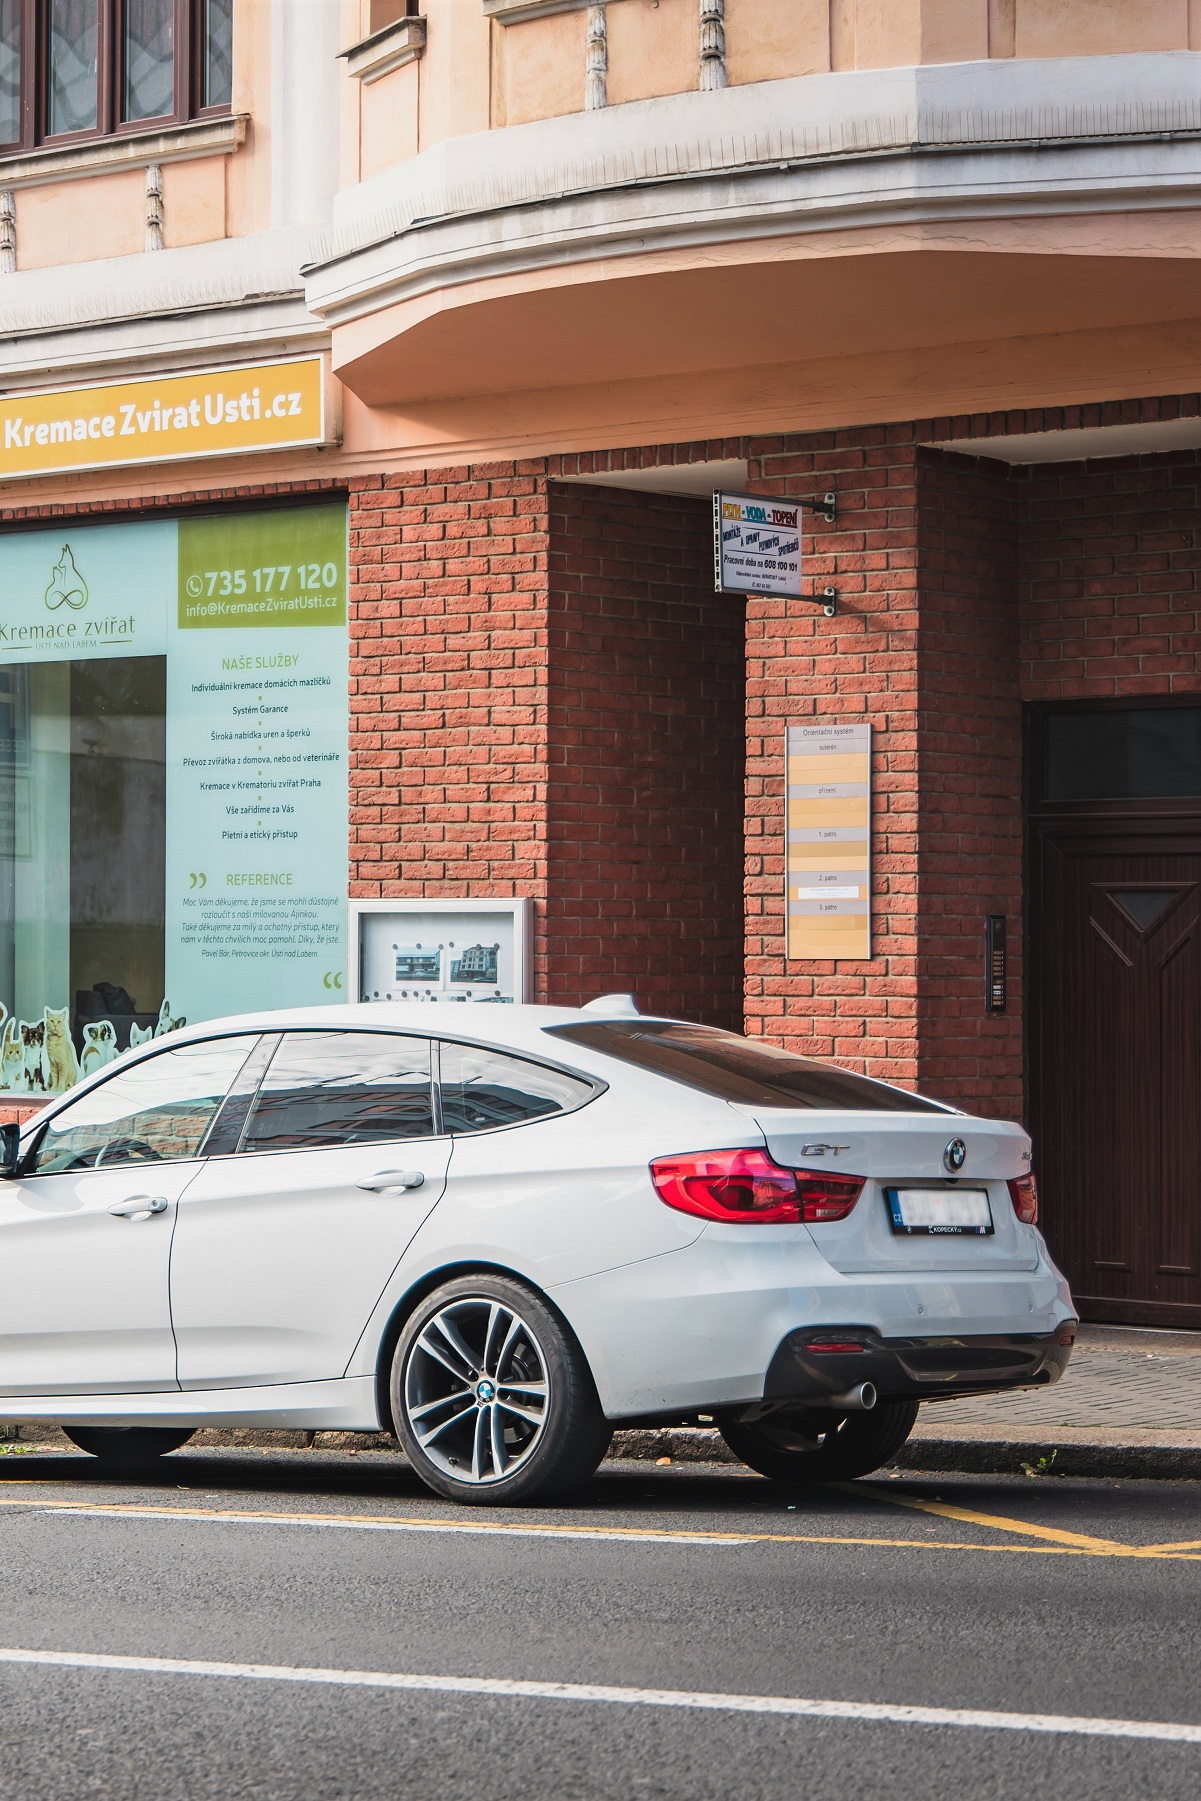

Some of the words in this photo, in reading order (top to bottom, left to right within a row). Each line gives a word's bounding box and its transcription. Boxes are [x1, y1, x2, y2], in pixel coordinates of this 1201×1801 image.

[723, 503, 741, 518] PLYN
[746, 506, 767, 521] VODA
[772, 508, 798, 525] TOPENÍ
[724, 555, 744, 566] Pracovní
[745, 556, 757, 567] doba
[765, 560, 776, 569] 608
[778, 562, 788, 571] 100
[789, 563, 798, 572] 101
[204, 569, 247, 597] 735
[253, 566, 291, 593] 177
[297, 562, 338, 590] 120
[186, 595, 337, 617] info@KremaceZviratUsti.cz
[85, 616, 136, 636] zvířat
[54, 641, 70, 650] NAD
[73, 640, 97, 648] LABEM
[222, 655, 253, 671] NAŠE
[255, 653, 299, 669] SLUŽBY
[234, 681, 263, 690] kremace
[232, 705, 259, 717] Systém
[260, 704, 289, 714] Garance
[211, 730, 233, 741] Široká
[803, 728, 833, 737] Orientační
[834, 728, 854, 737] systém
[183, 757, 207, 767] Převoz
[208, 756, 236, 766] zvířátka
[243, 756, 272, 765] domova,
[274, 754, 292, 763] nebo
[293, 754, 302, 763] od
[303, 753, 340, 762] veterináře
[200, 782, 230, 791] Kremace
[238, 781, 277, 790] Krematoriu
[300, 779, 322, 788] Praha
[226, 806, 239, 815] Vše
[272, 806, 280, 814] za
[281, 804, 295, 813] Vás
[250, 830, 271, 841] etický
[826, 831, 837, 839] patro
[226, 874, 293, 886] REFERENCE
[183, 898, 197, 907] Moc
[198, 898, 214, 907] Vám
[251, 897, 259, 906] že
[259, 897, 276, 907] jsme
[278, 898, 286, 906] se
[287, 897, 307, 906] mohli
[825, 904, 838, 912] patro
[201, 910, 231, 919] rozloučit
[253, 909, 289, 919] milovanou
[182, 923, 197, 931] Také
[199, 923, 231, 933] děkujeme
[242, 922, 257, 933] milý
[264, 922, 292, 932] ochotný
[321, 922, 340, 932] který
[181, 935, 196, 944] nám
[203, 935, 224, 944] těchto
[253, 936, 267, 944] moc
[268, 935, 296, 945] pomohl.
[317, 935, 325, 943] že
[202, 950, 218, 958] Pavel
[232, 950, 259, 958] Petrovice
[284, 950, 296, 958] nad
[297, 950, 318, 958] Labem
